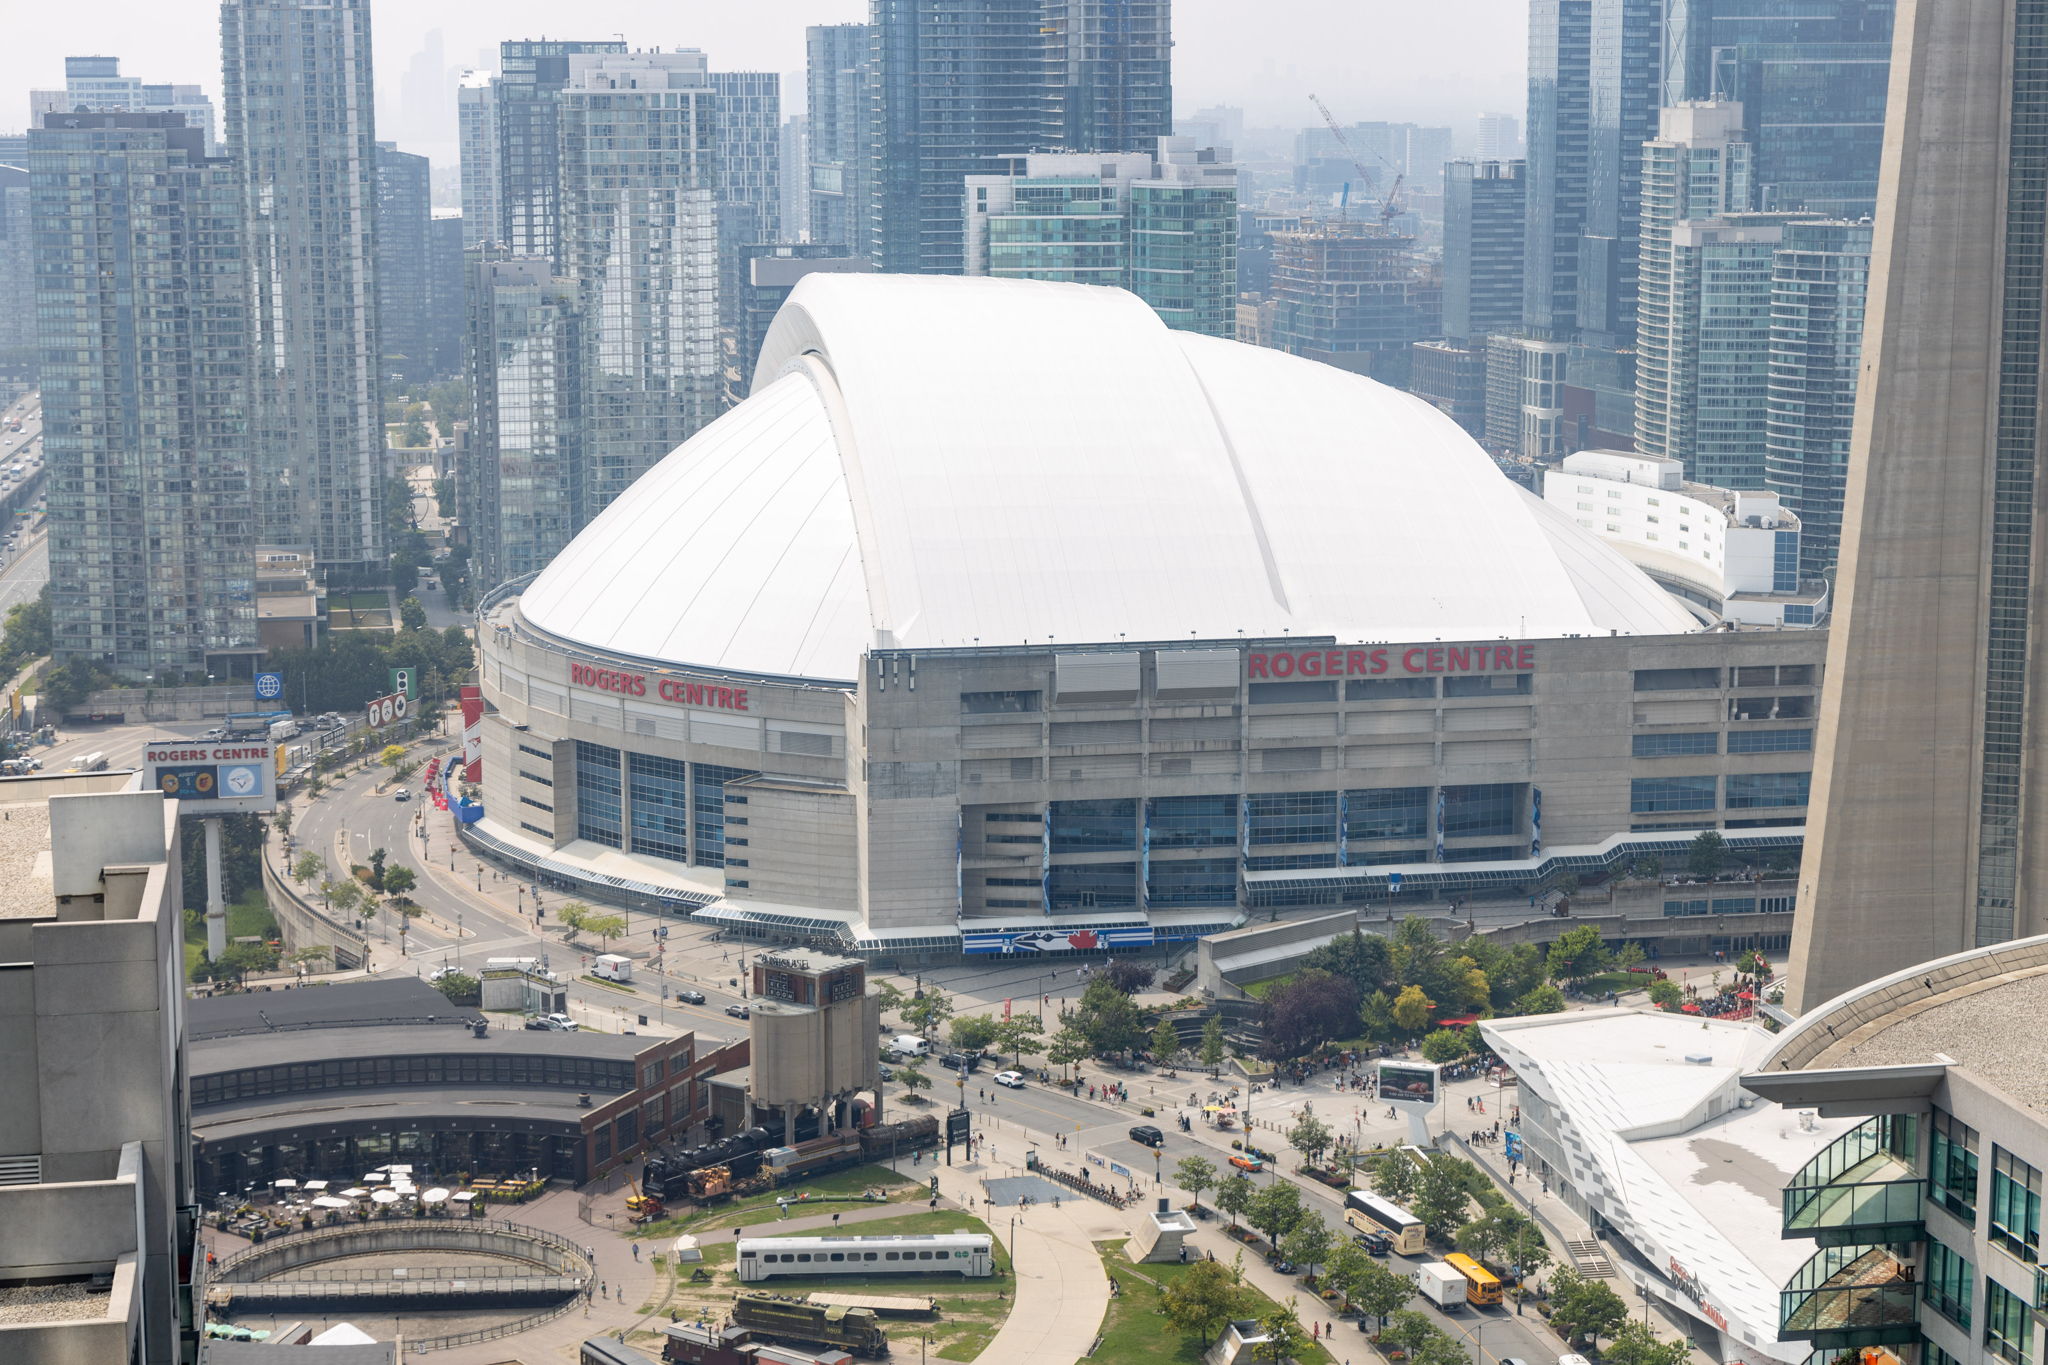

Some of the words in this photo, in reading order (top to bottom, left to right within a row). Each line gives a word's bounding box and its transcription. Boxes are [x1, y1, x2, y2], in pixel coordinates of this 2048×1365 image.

[1248, 648, 1388, 679] ROGERS
[1402, 644, 1535, 673] CENTRE
[571, 663, 647, 697] ROGERS
[658, 678, 749, 710] CENTRE
[147, 749, 207, 762] ROGERS
[212, 747, 269, 760] CENTRE
[185, 777, 192, 786] 1
[770, 989, 793, 1000] ROOM
